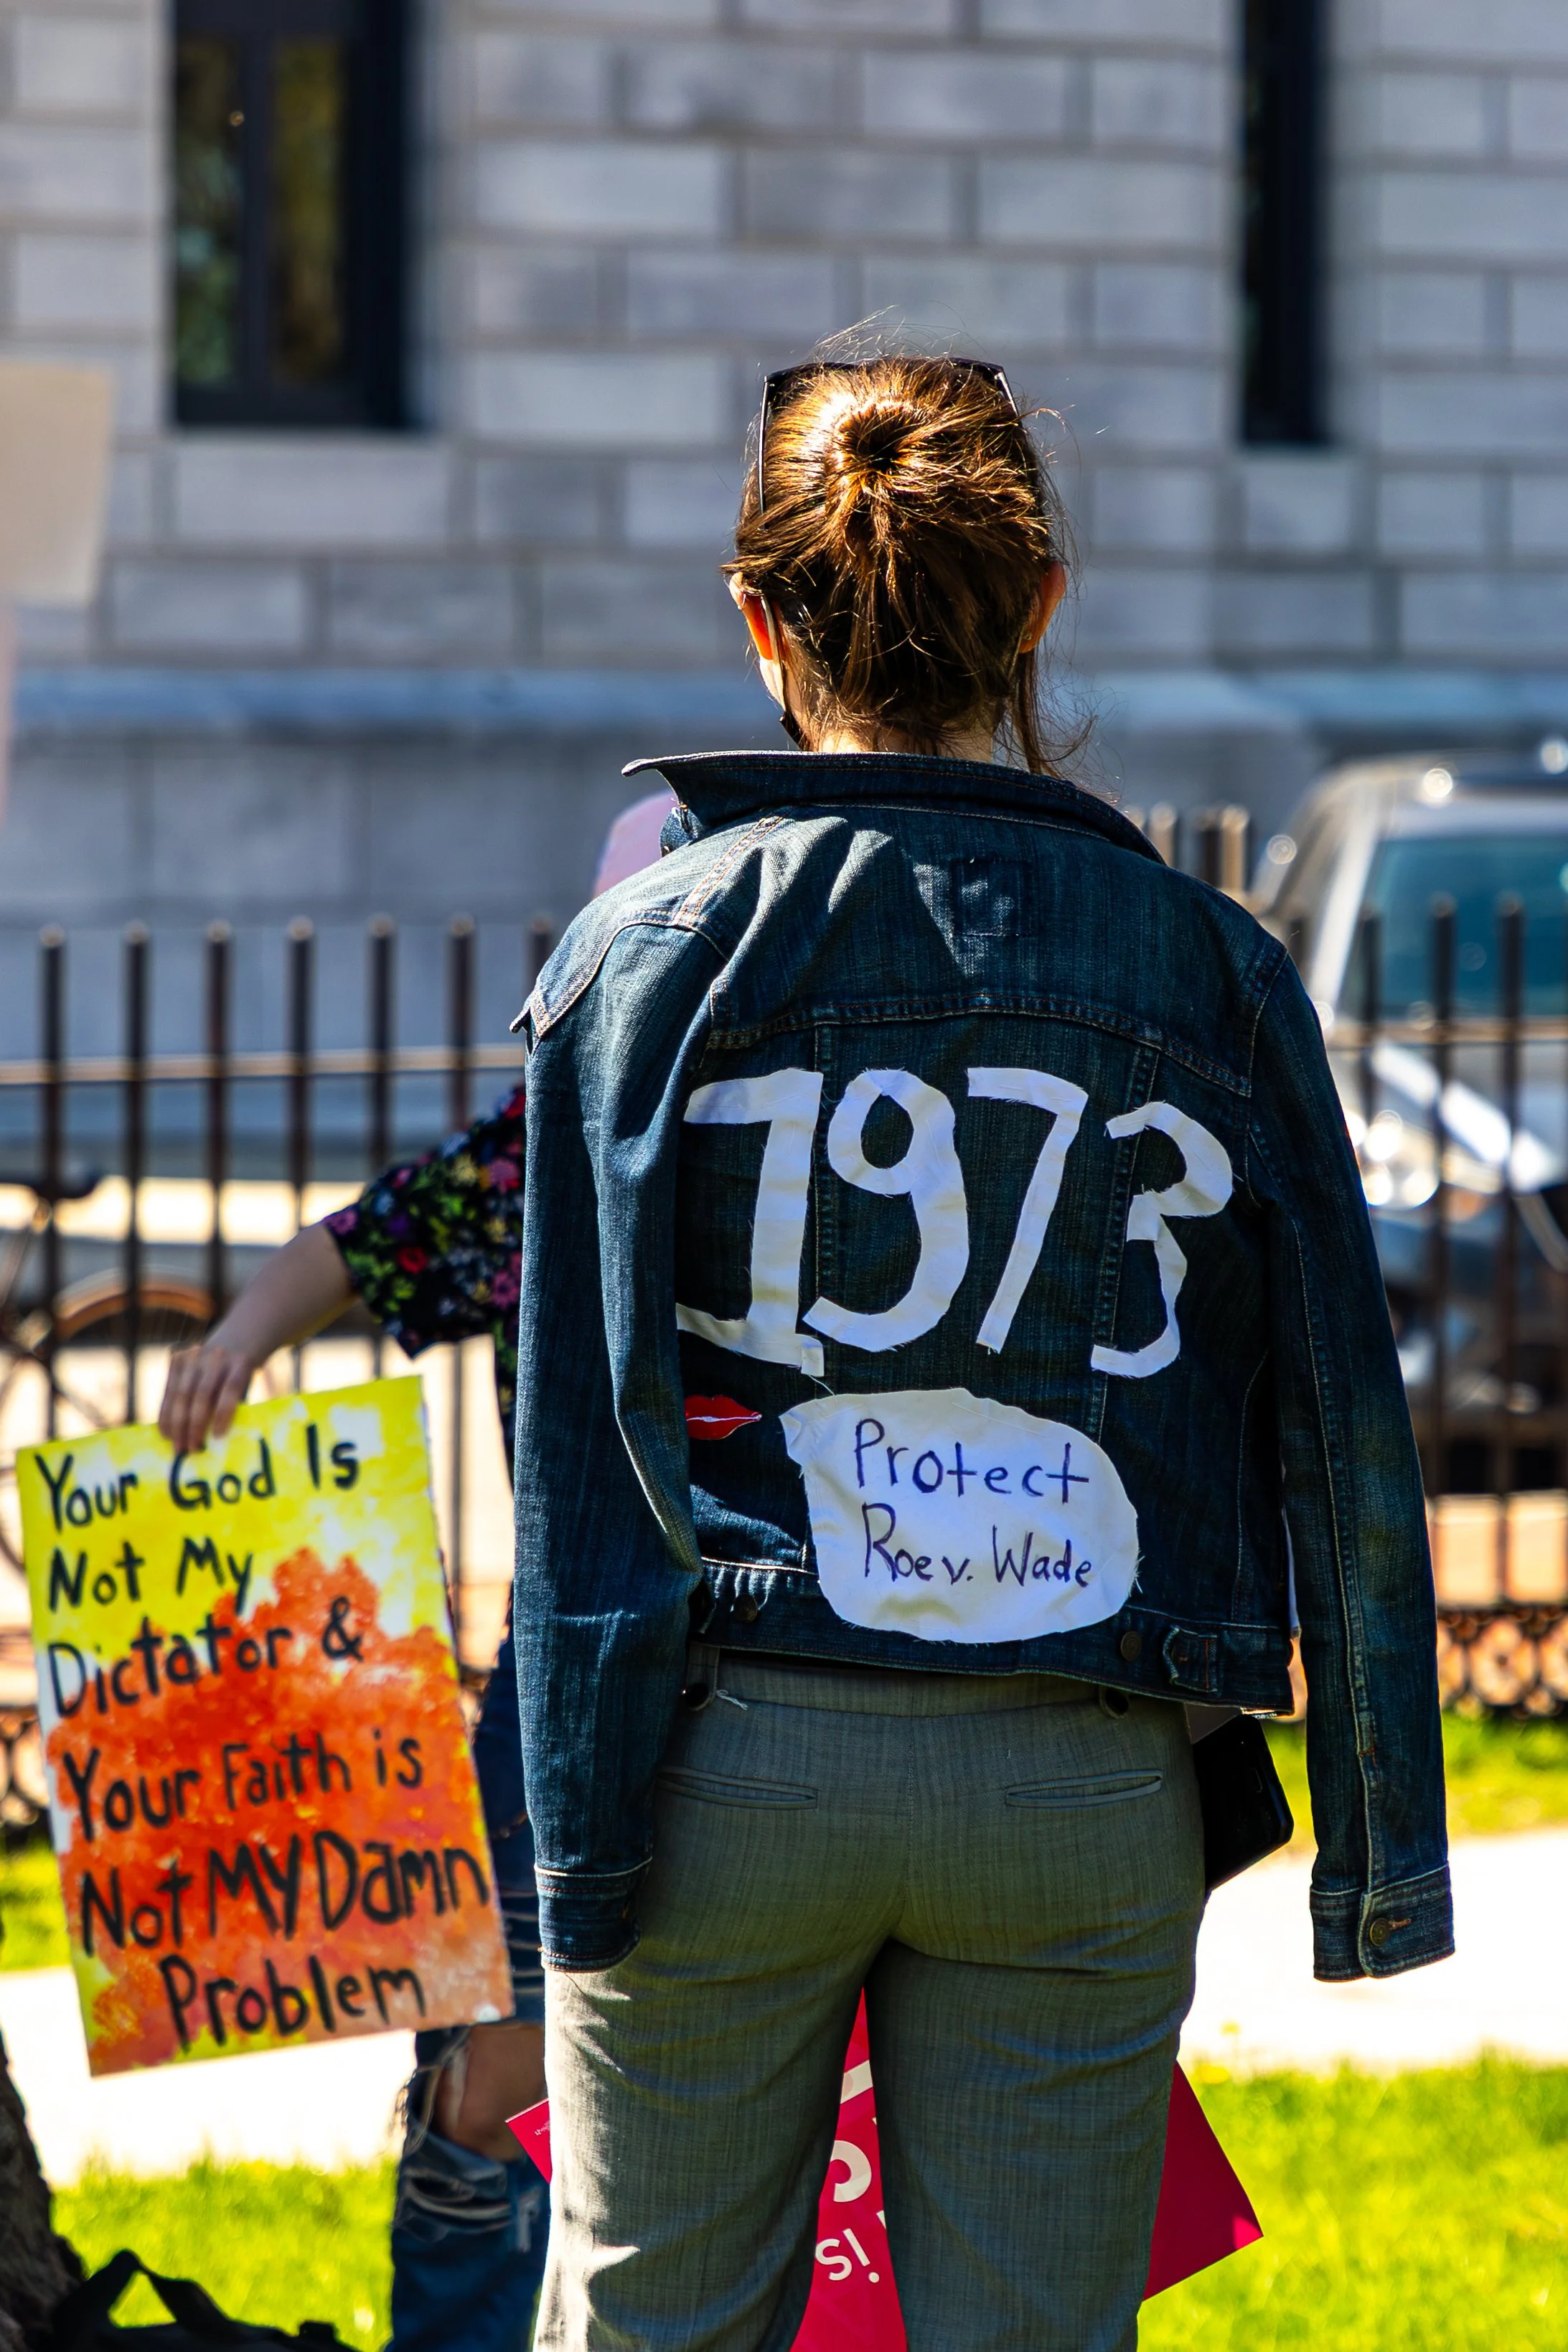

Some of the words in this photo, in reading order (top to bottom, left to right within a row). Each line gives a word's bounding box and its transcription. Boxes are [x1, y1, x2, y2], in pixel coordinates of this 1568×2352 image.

[677, 1067, 1233, 1378] 1973
[35, 1453, 139, 1533] Your
[169, 1438, 276, 1510] God
[306, 1424, 358, 1490] Is
[854, 1418, 1090, 1504] Protect
[48, 1542, 145, 1613] Not
[176, 1537, 253, 1615] My
[862, 1503, 932, 1583] Roe
[992, 1525, 1093, 1588] Wade
[48, 1616, 294, 1718] Dictator
[322, 1596, 364, 1662] &
[63, 1748, 200, 1842] Your
[222, 1733, 352, 1810] Faith
[375, 1730, 422, 1790] is
[80, 1859, 192, 1956] Not
[317, 1829, 489, 1932] Damn
[159, 1954, 426, 2052] Problem
